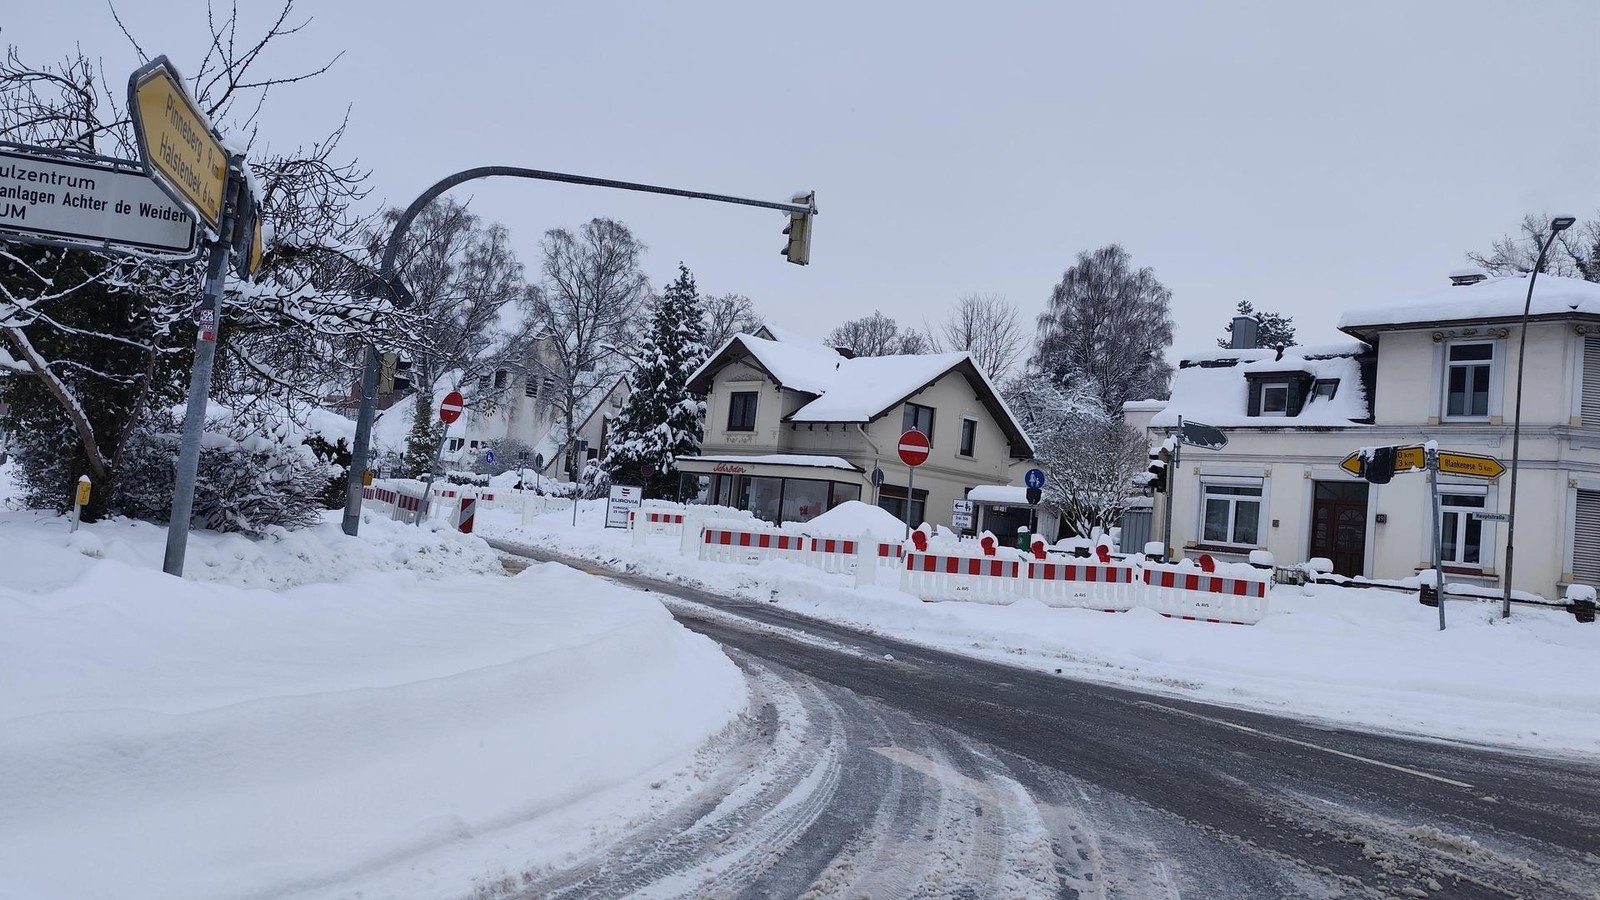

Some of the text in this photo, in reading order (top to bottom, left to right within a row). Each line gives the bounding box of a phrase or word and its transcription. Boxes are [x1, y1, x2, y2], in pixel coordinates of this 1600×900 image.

[165, 92, 220, 180] Pinneberg 9 km
[0, 164, 96, 191] ulzentrum
[159, 131, 215, 214] Halstenbek 6 km
[0, 184, 187, 223] anlagen Achter de Weiden
[1445, 458, 1476, 470] Blankenese
[1478, 463, 1483, 471] 5
